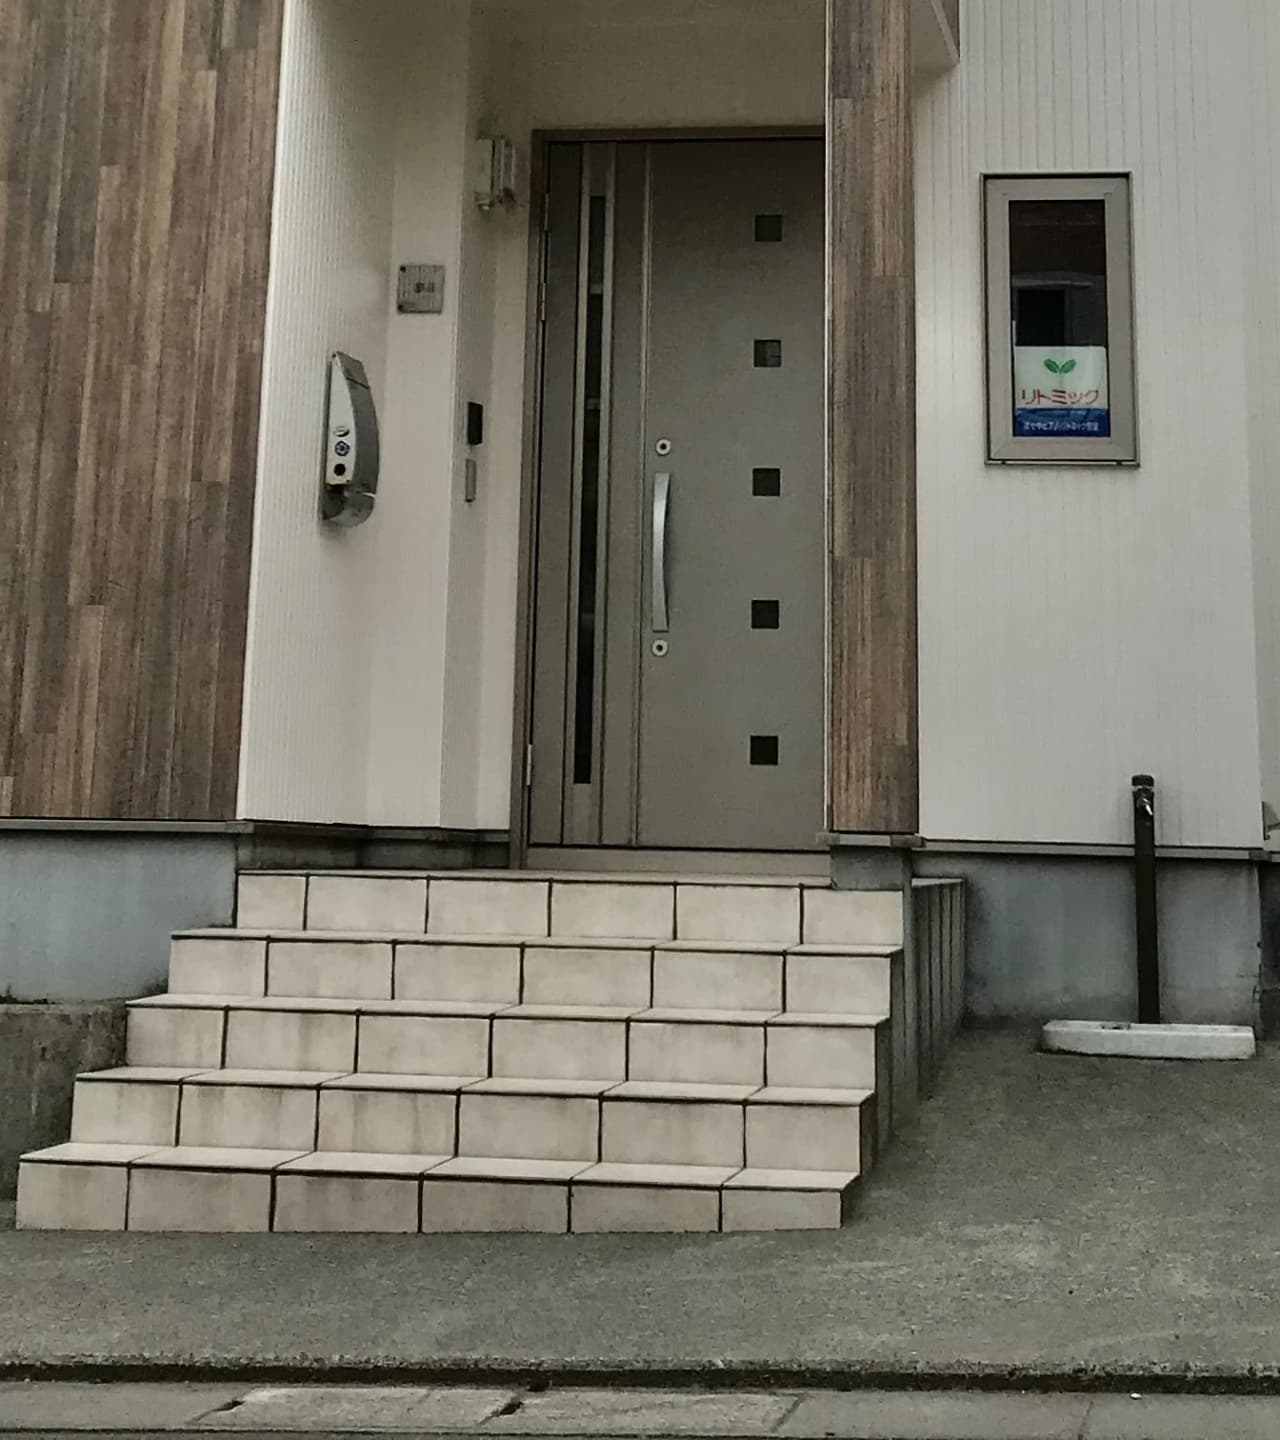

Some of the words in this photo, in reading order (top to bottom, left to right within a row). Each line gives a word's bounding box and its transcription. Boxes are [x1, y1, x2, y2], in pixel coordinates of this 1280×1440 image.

[1021, 389, 1099, 405] リトミック
